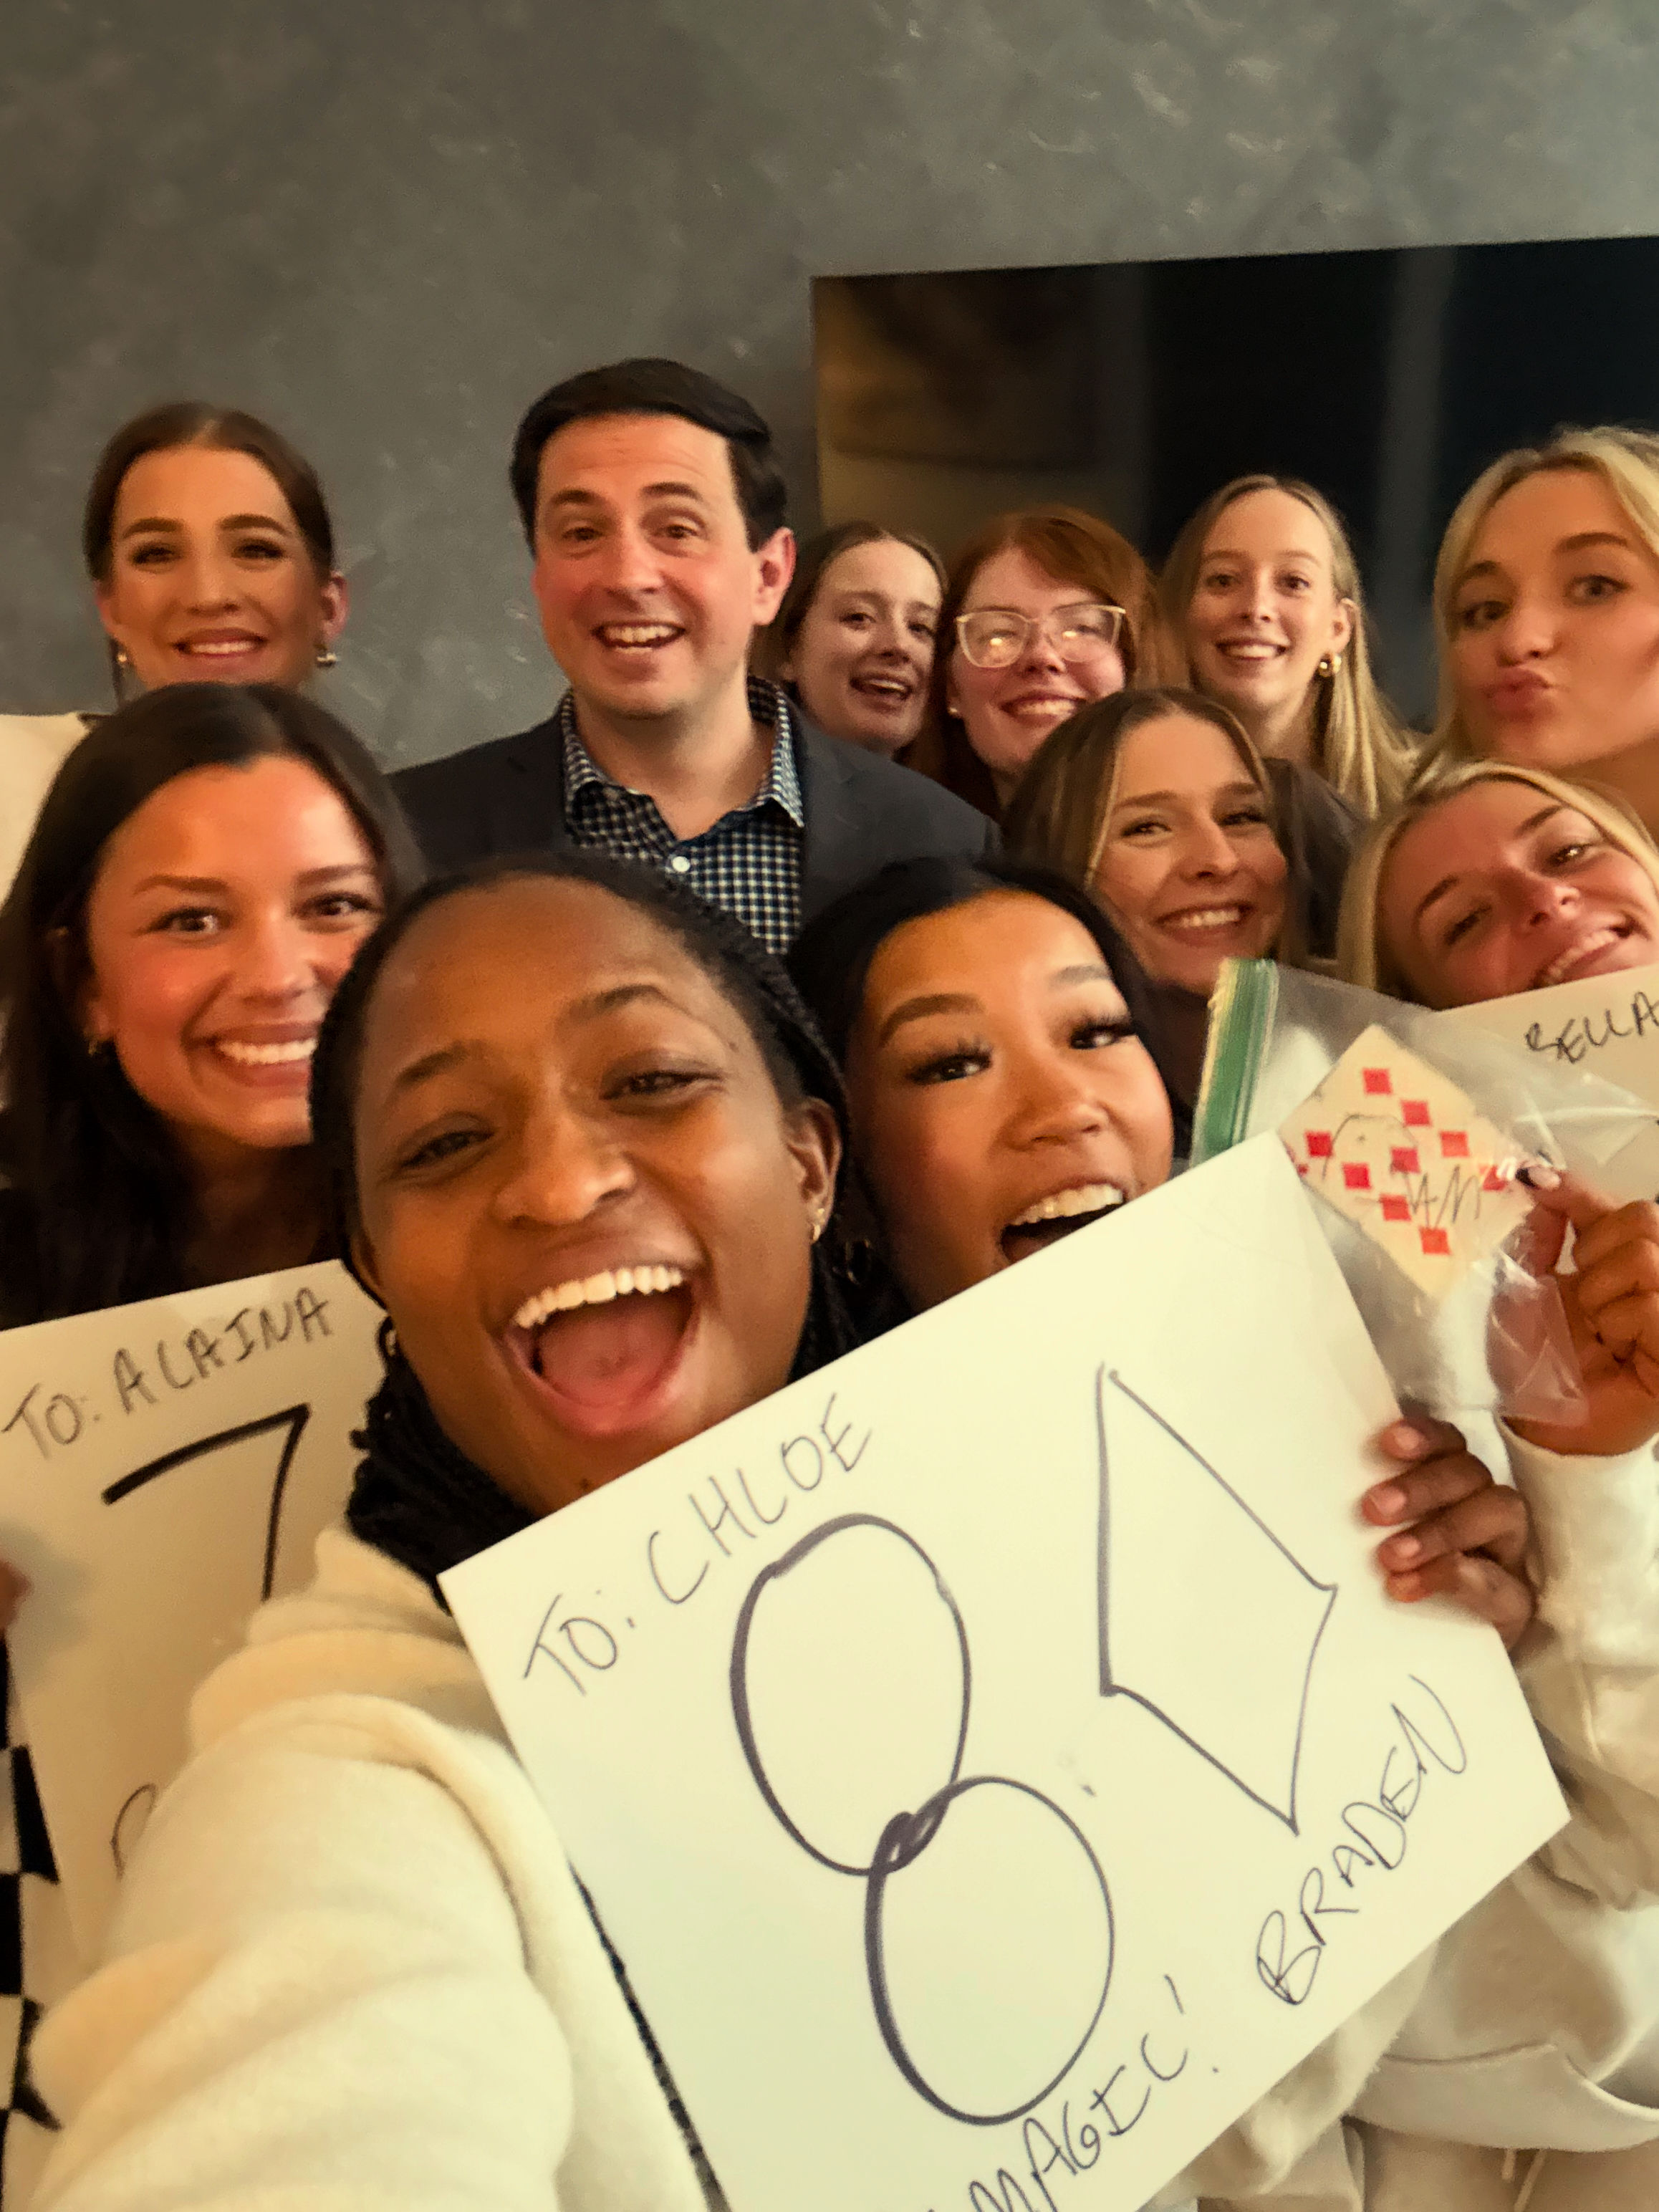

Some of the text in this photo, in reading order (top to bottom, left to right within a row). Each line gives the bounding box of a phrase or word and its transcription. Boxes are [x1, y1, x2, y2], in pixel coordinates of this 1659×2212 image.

[1, 1383, 101, 1459] TO:
[524, 1393, 872, 1696] TO: CHLOE
[729, 1512, 1115, 2127] 8
[1256, 1674, 1467, 2005] BRADEN
